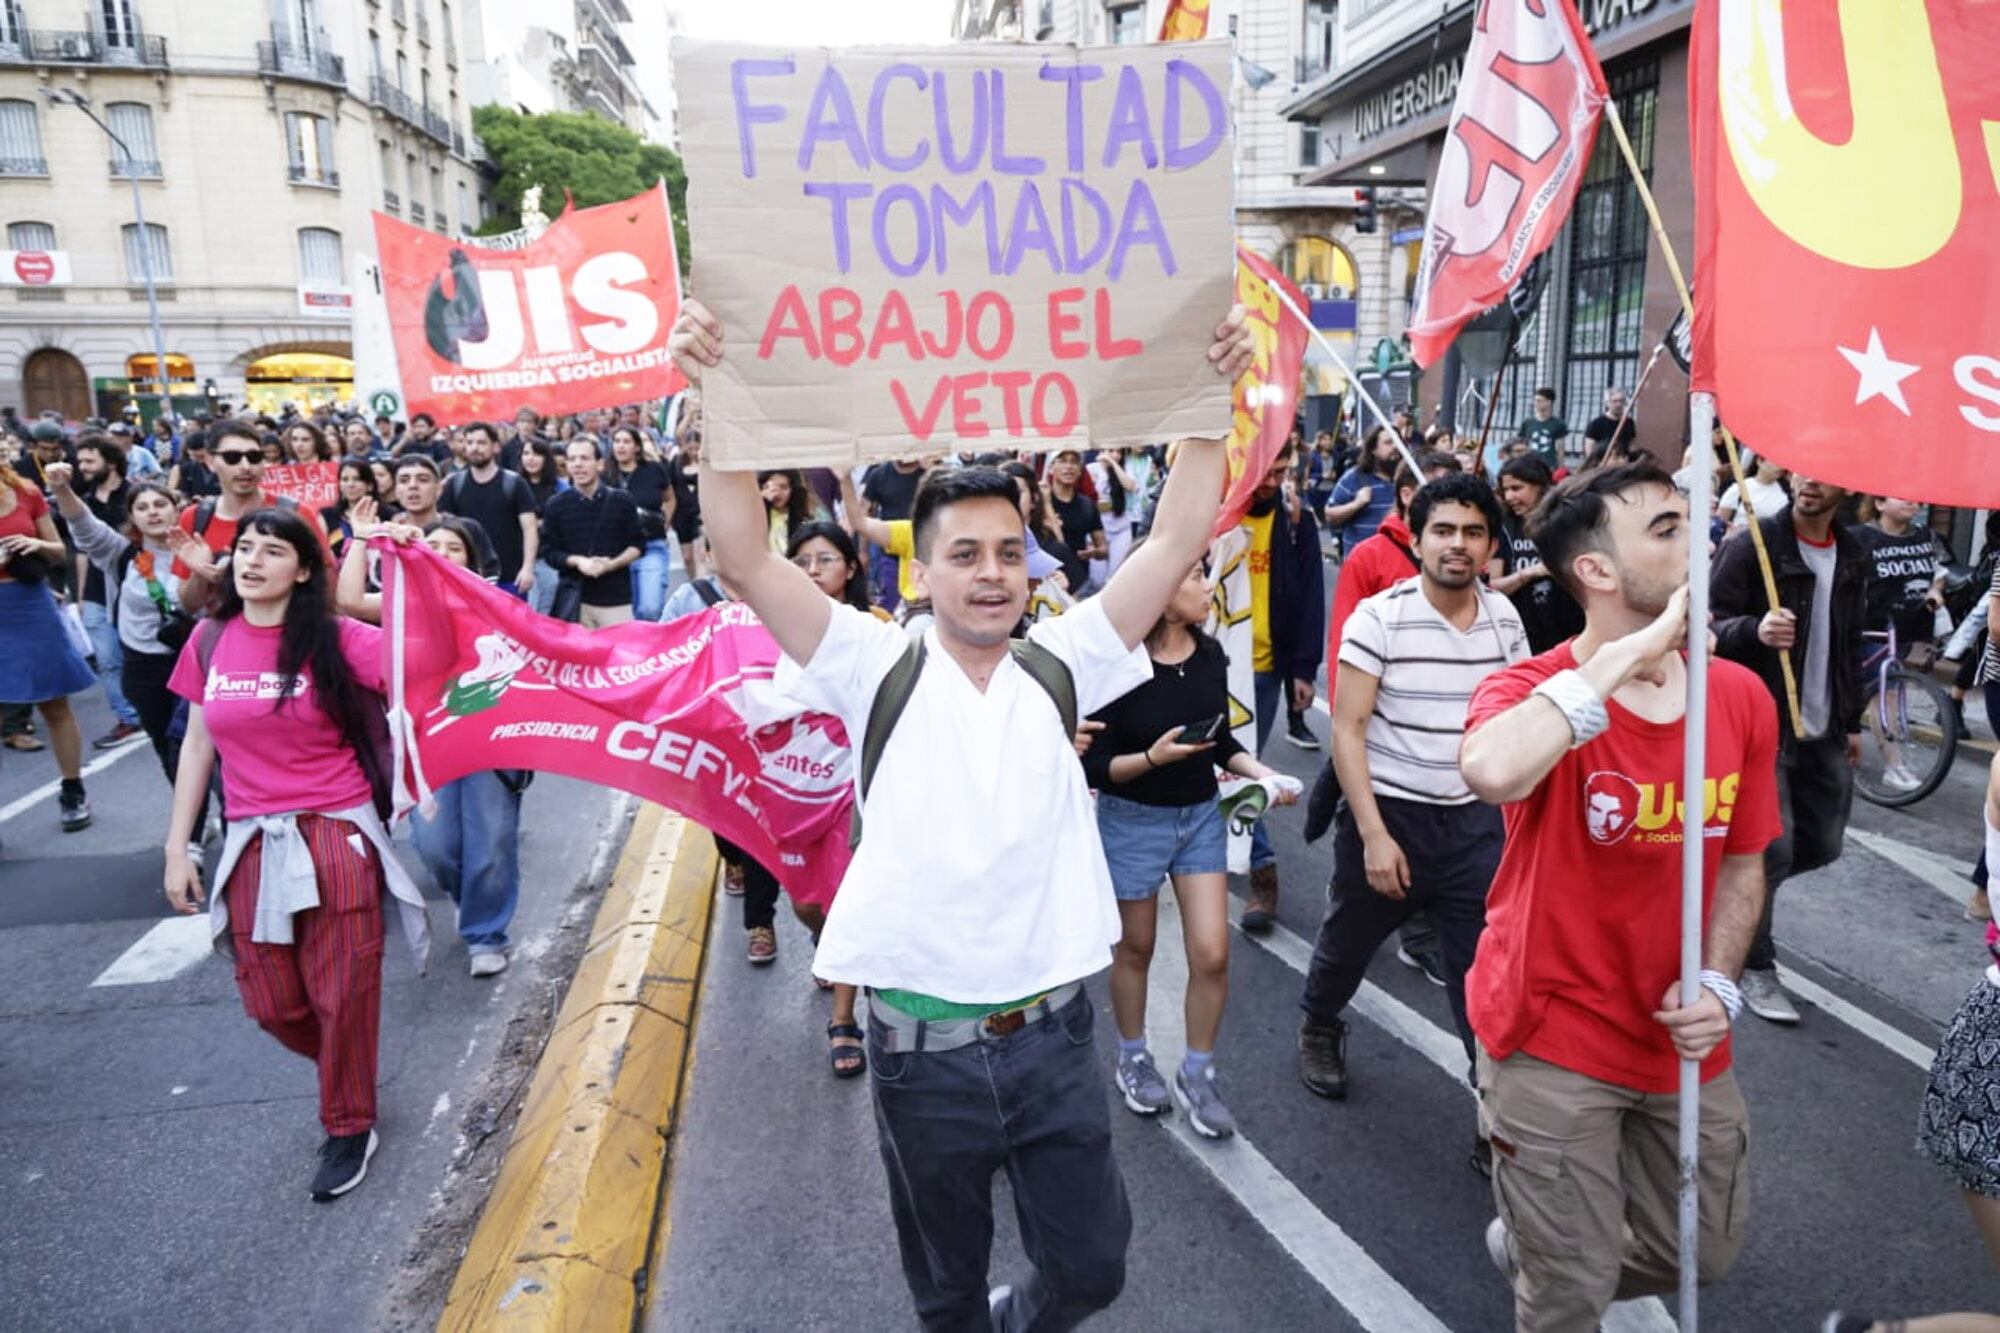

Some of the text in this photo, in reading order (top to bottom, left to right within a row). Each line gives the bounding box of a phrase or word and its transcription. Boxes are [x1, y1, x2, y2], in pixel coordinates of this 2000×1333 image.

[732, 58, 1227, 178] FACULTAD
[1718, 0, 2000, 269] U
[803, 178, 1177, 281] TOMADA
[457, 251, 659, 370] JIS
[757, 284, 1144, 366] ABAJO EL
[431, 369, 556, 394] IZQUIERDA
[890, 370, 1080, 440] VETO
[1953, 354, 2000, 433] S
[489, 721, 599, 741] PRESIDENCIA
